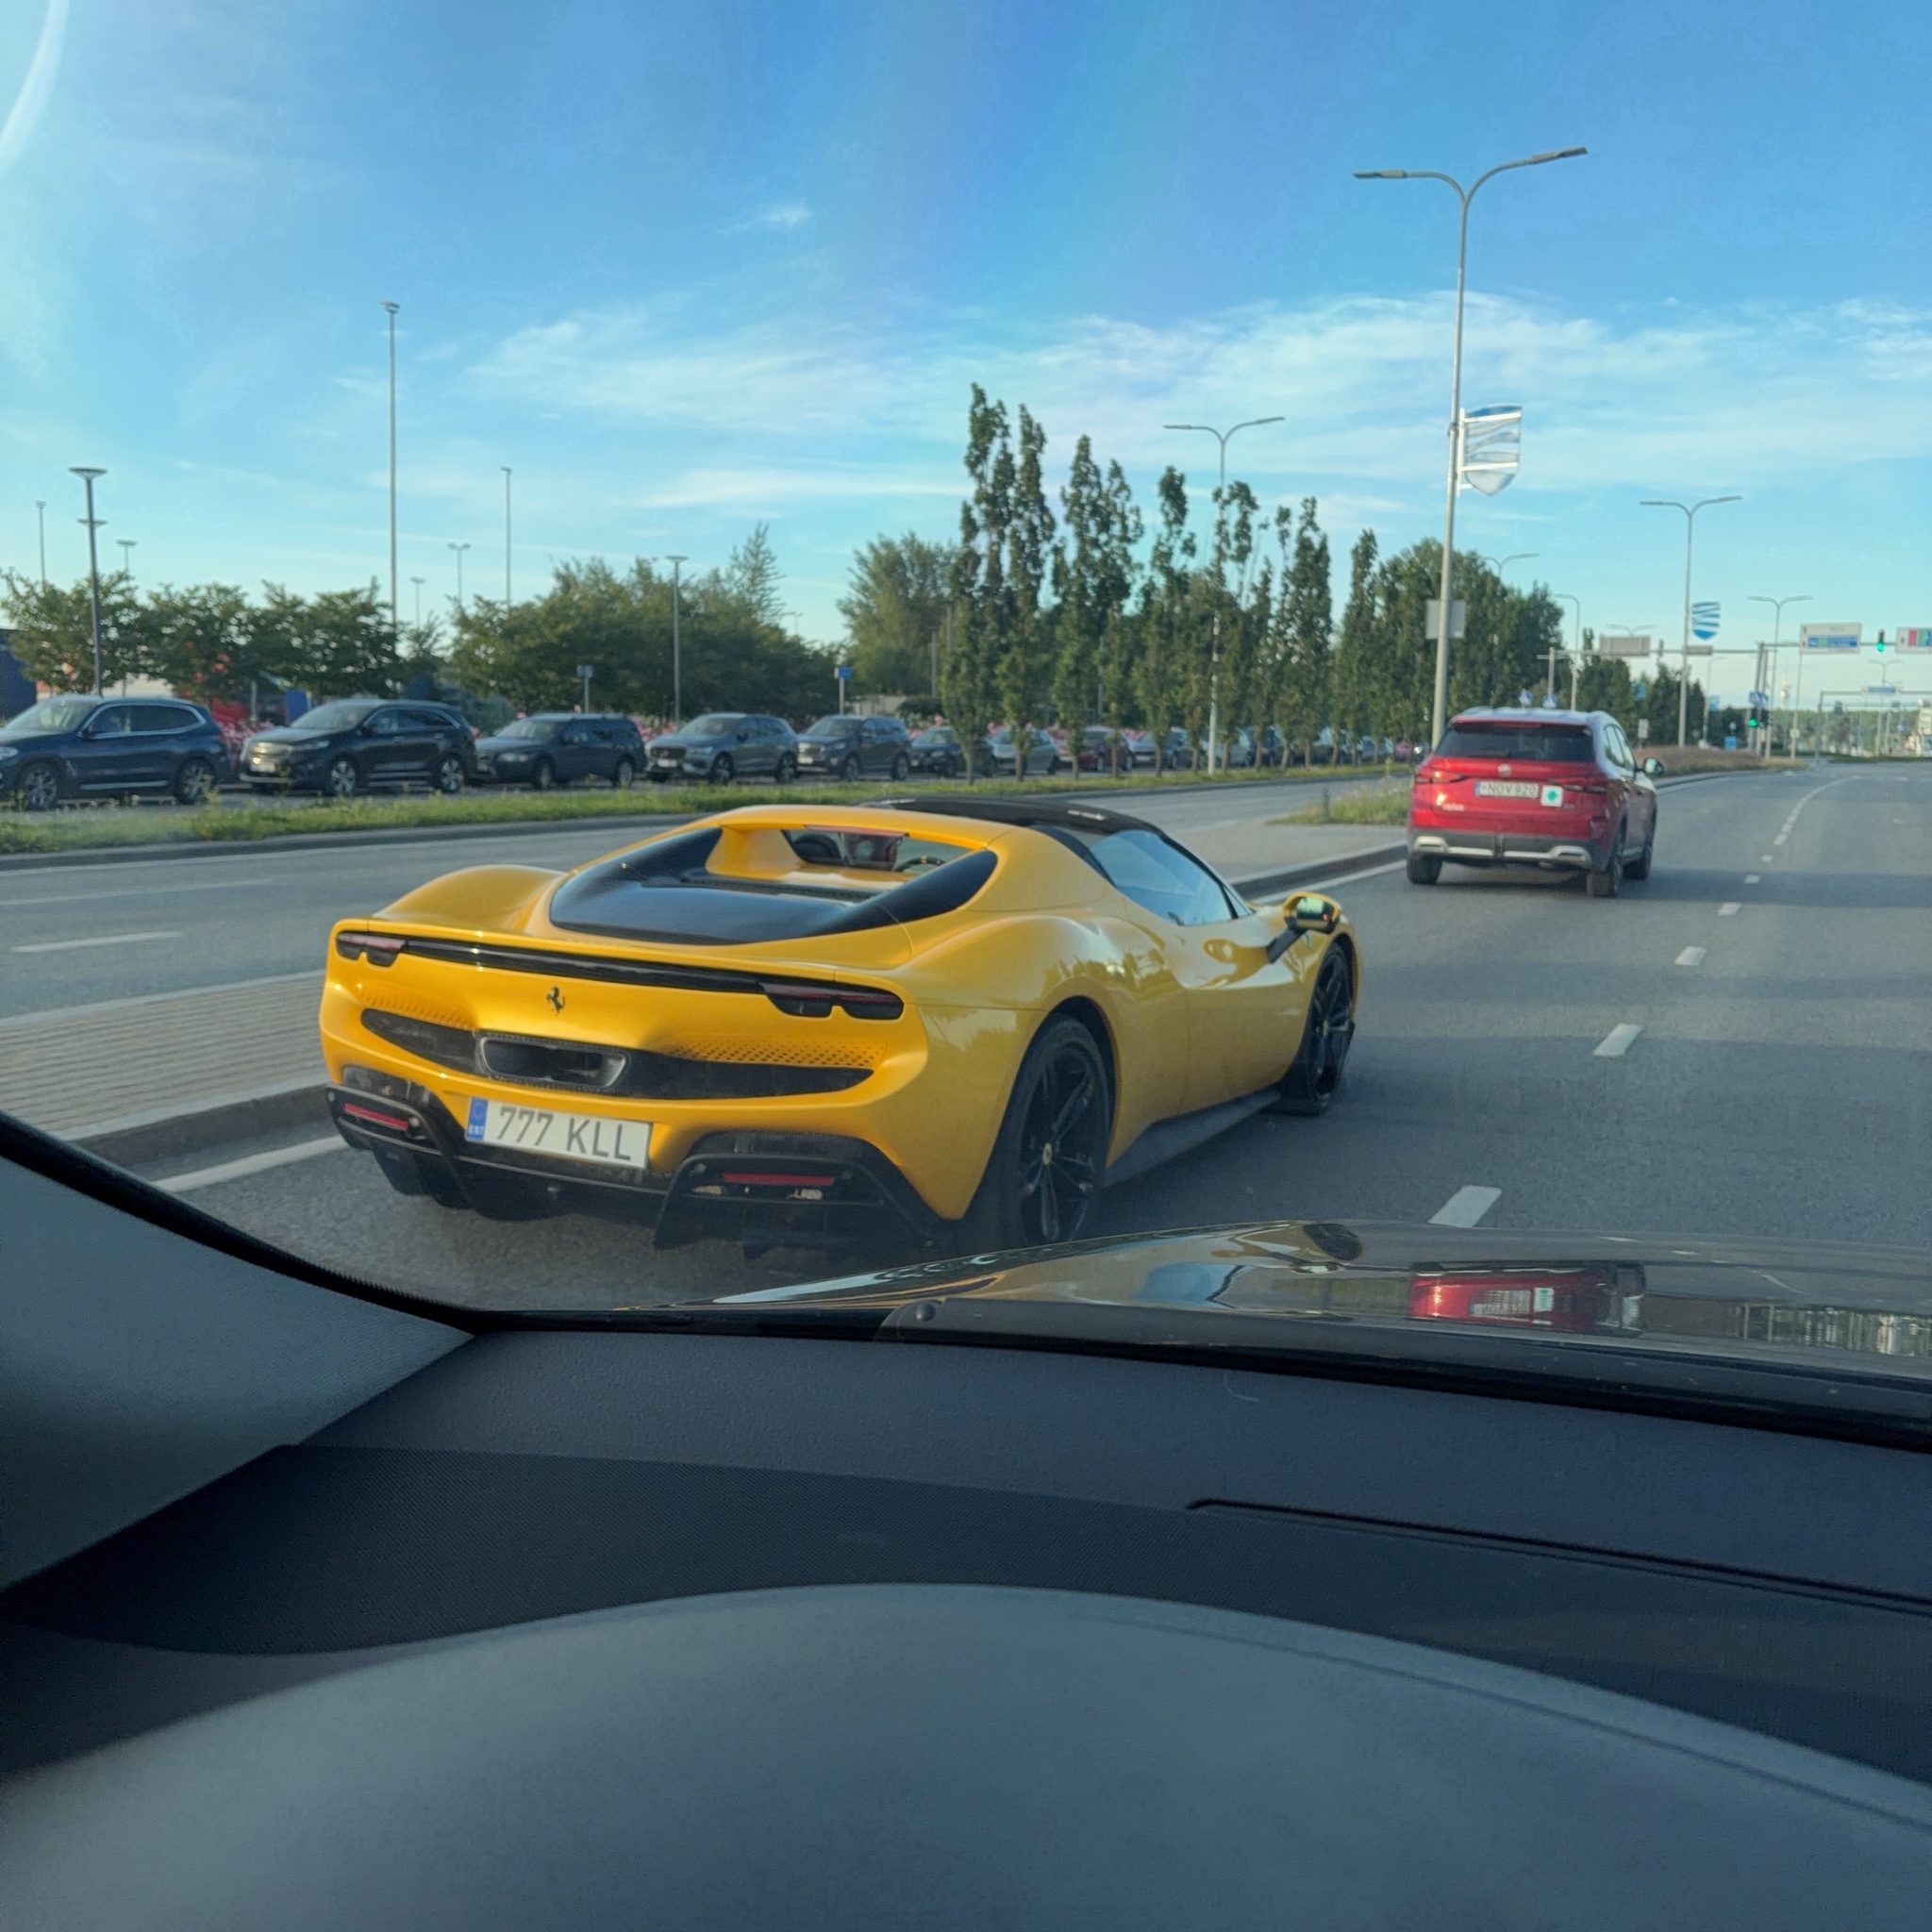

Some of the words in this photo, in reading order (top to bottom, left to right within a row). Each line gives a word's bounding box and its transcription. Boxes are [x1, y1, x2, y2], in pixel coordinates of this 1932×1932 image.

[469, 1124, 485, 1136] EST
[496, 1106, 555, 1146] 777
[566, 1117, 631, 1161] KLL
